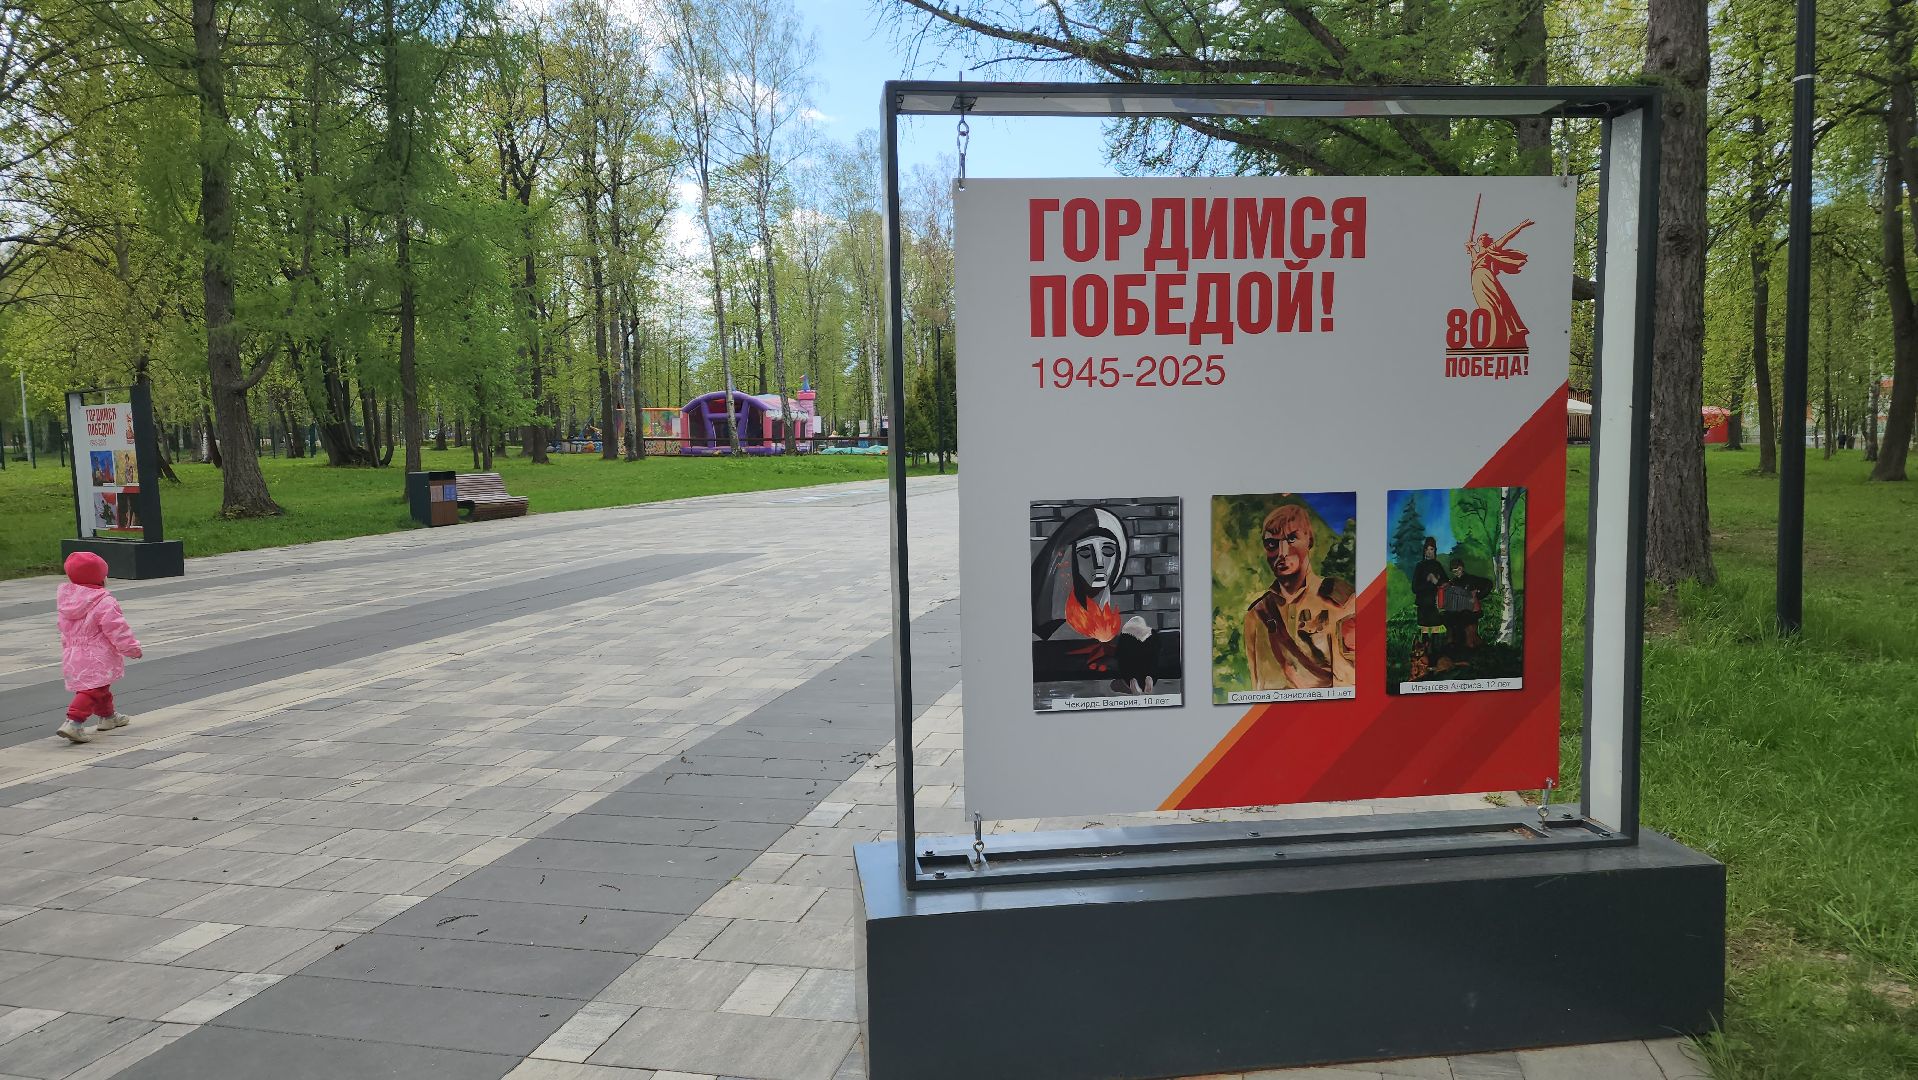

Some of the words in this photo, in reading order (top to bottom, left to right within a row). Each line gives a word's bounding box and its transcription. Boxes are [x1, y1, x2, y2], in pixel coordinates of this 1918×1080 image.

[1029, 197, 1366, 271] ГОРДИМСЯ
[1029, 260, 1335, 345] ПОБЕДОЙ!
[1446, 308, 1491, 349] 80
[1032, 355, 1226, 388] 1945-2025
[1445, 355, 1529, 380] ПОБЕДА!
[1143, 697, 1153, 705] 10
